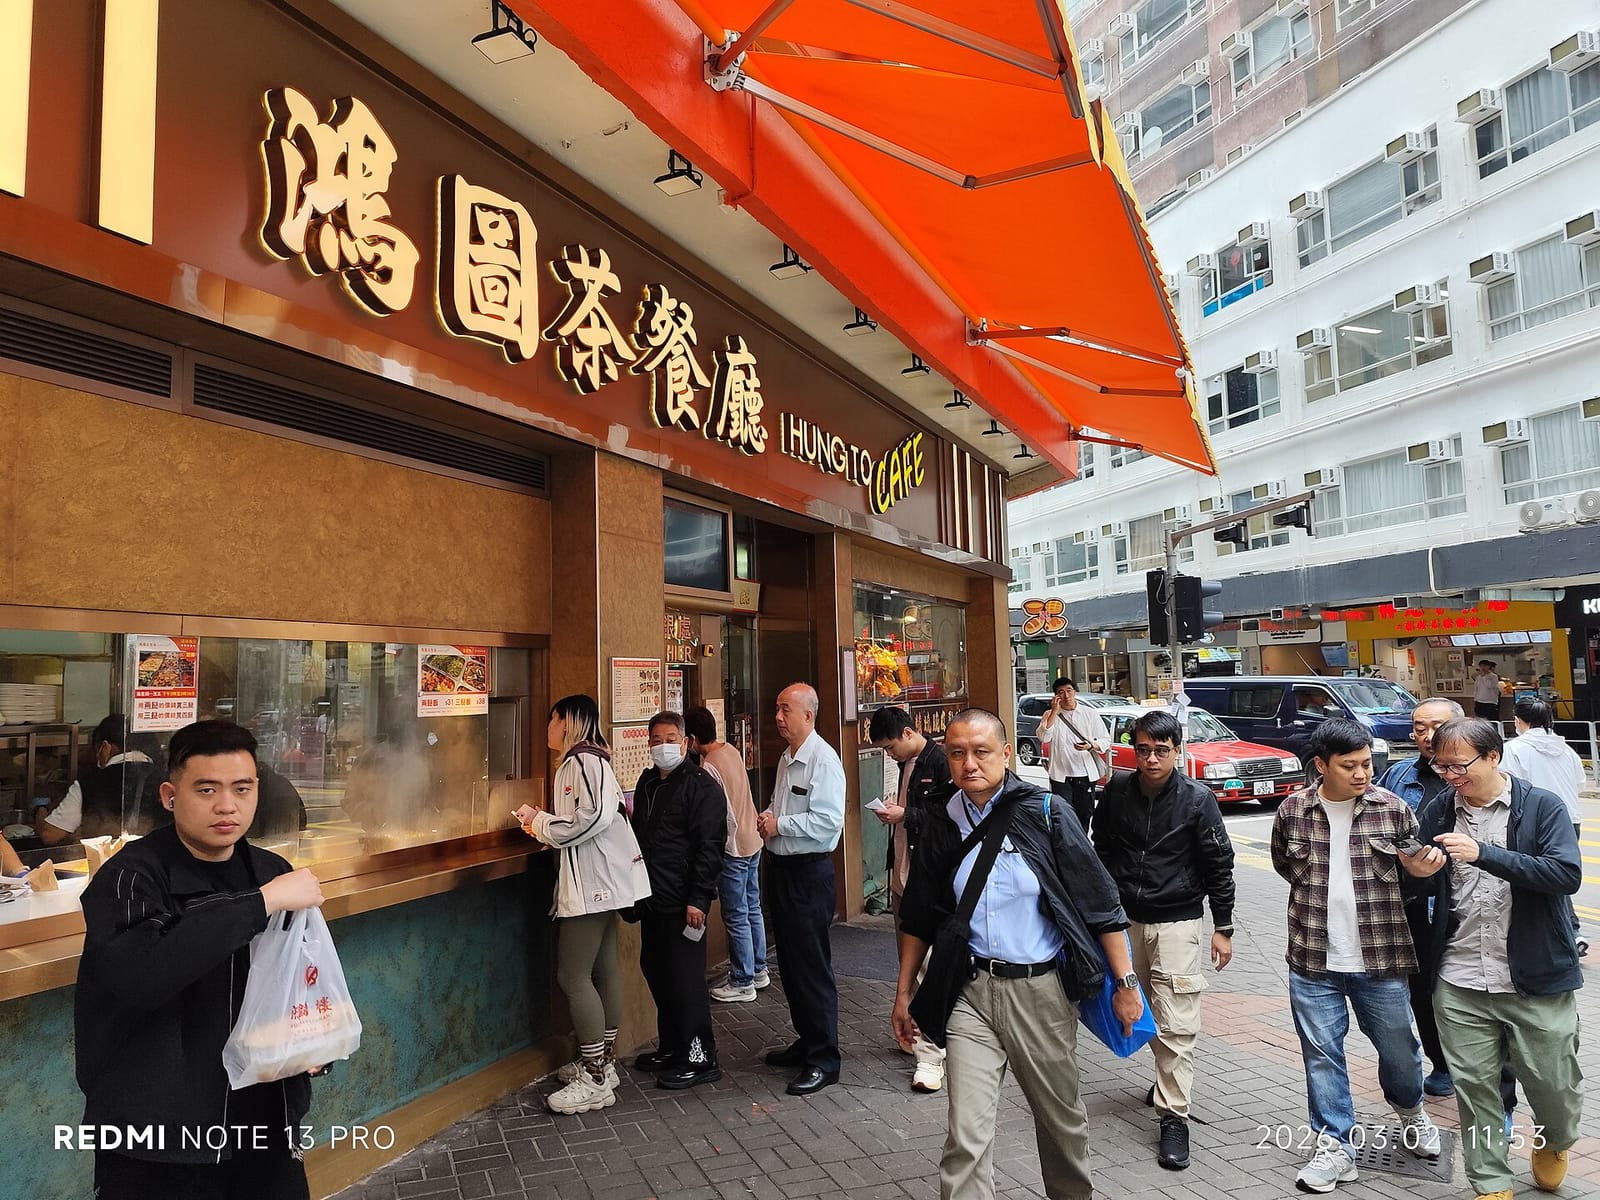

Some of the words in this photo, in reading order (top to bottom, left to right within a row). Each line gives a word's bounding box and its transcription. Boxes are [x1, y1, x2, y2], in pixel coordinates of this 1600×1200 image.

[259, 86, 768, 457] 鴻圖茶餐廳
[783, 412, 847, 476] HUNG
[848, 443, 872, 486] TO
[871, 431, 925, 514] CAFE
